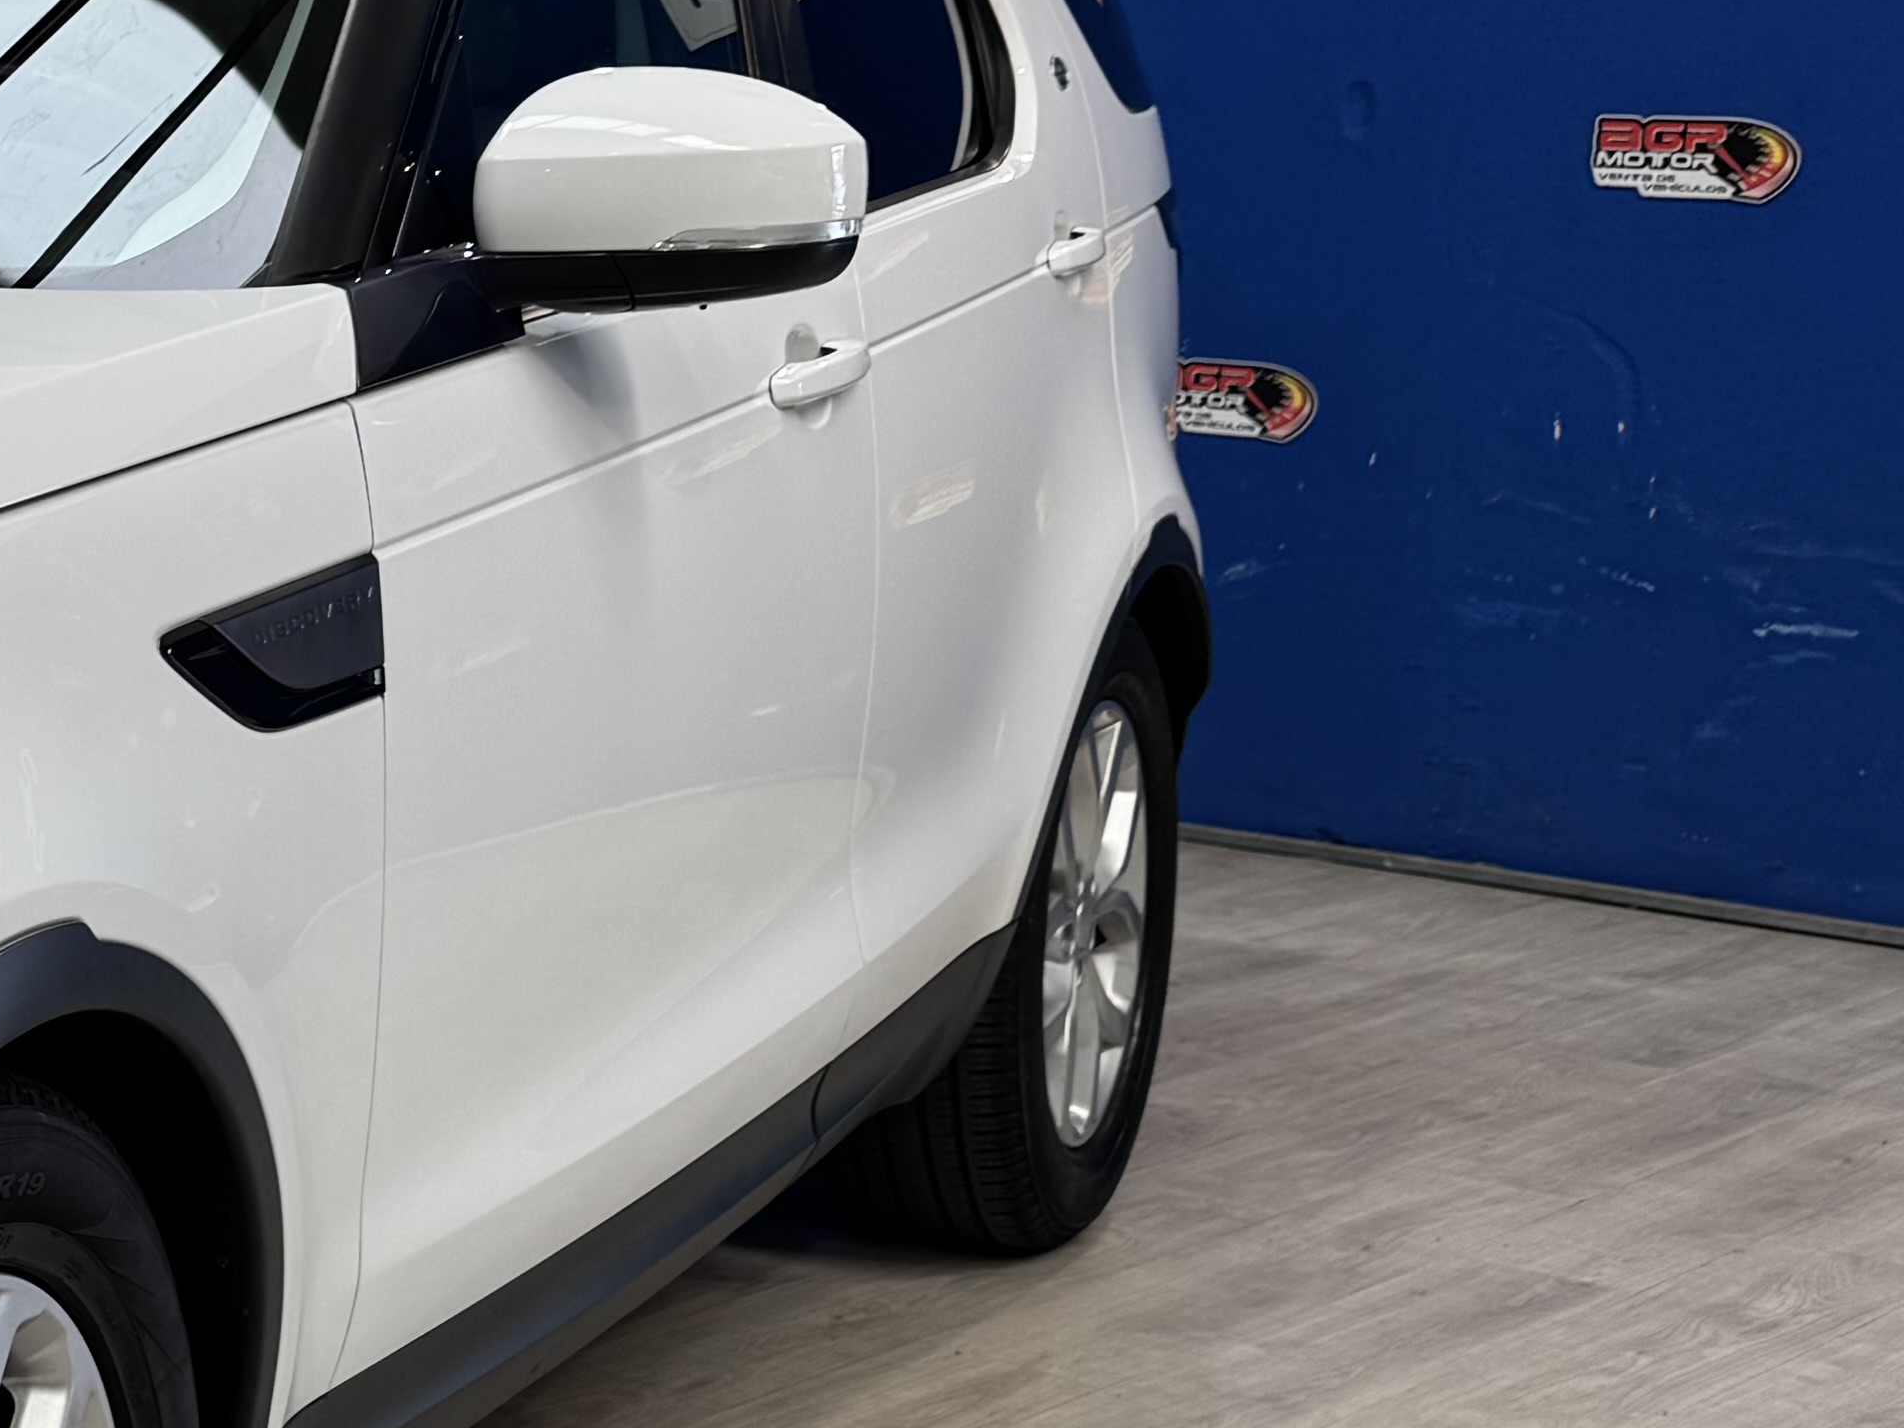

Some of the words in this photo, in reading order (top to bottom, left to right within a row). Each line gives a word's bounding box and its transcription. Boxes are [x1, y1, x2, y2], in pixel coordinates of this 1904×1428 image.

[1600, 121, 1729, 153] AGR
[1595, 150, 1719, 174] MOTOR
[1178, 363, 1255, 393] GR
